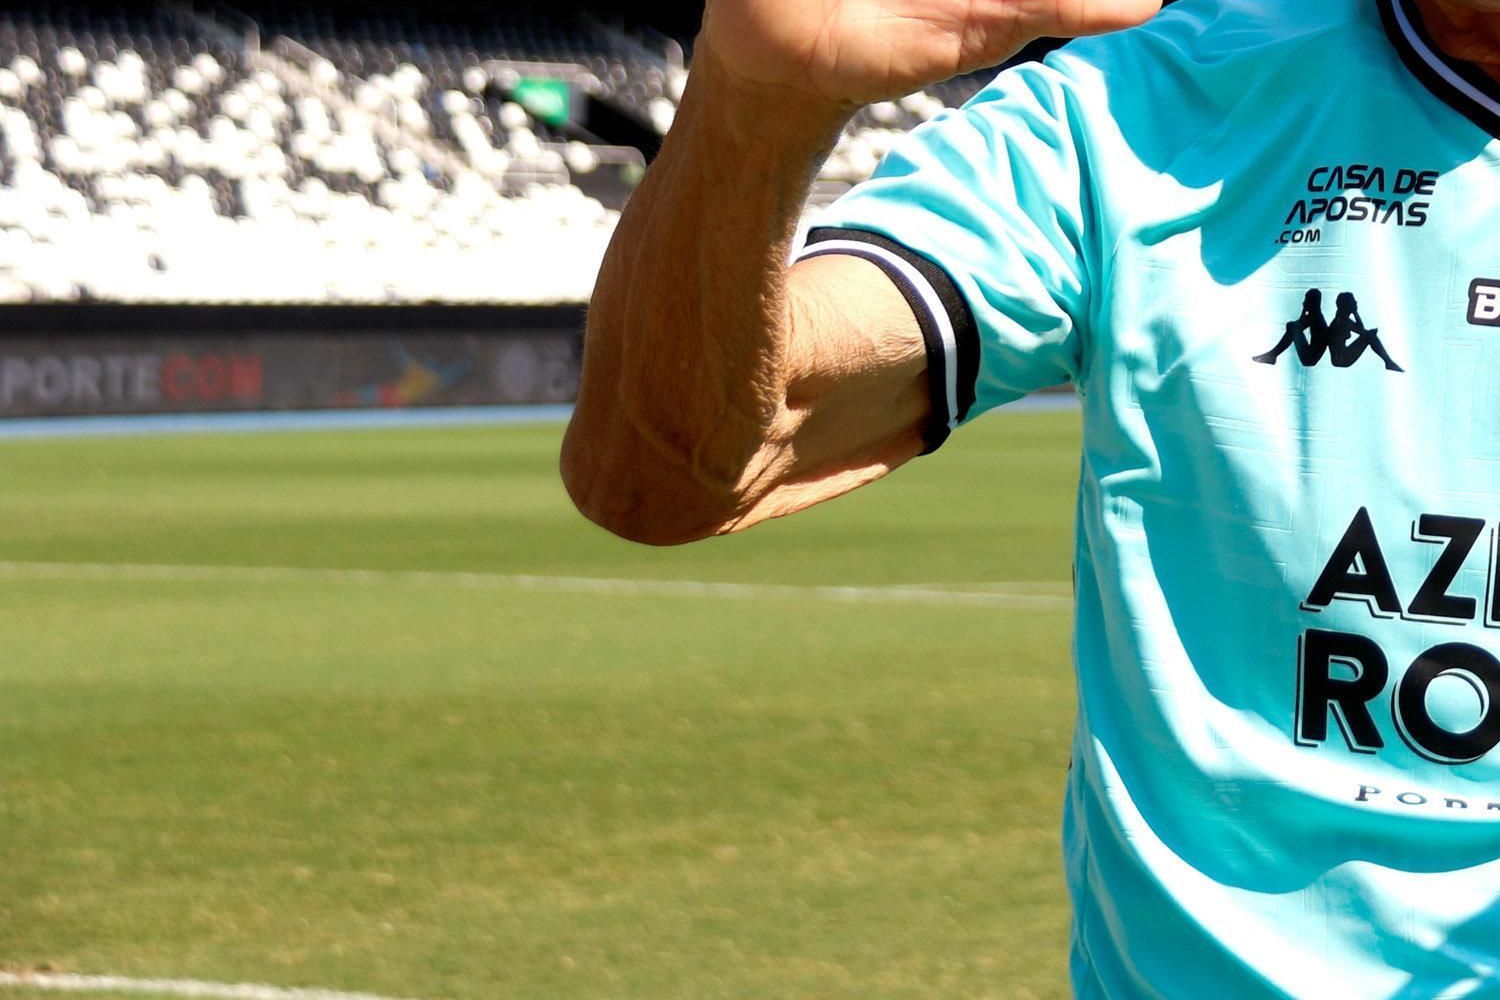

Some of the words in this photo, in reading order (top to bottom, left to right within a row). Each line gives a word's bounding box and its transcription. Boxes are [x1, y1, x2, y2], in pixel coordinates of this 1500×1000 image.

[1308, 164, 1385, 193] CASA
[1393, 168, 1440, 196] DE
[1285, 196, 1430, 227] APOSTAS
[1274, 228, 1321, 244] .COM
